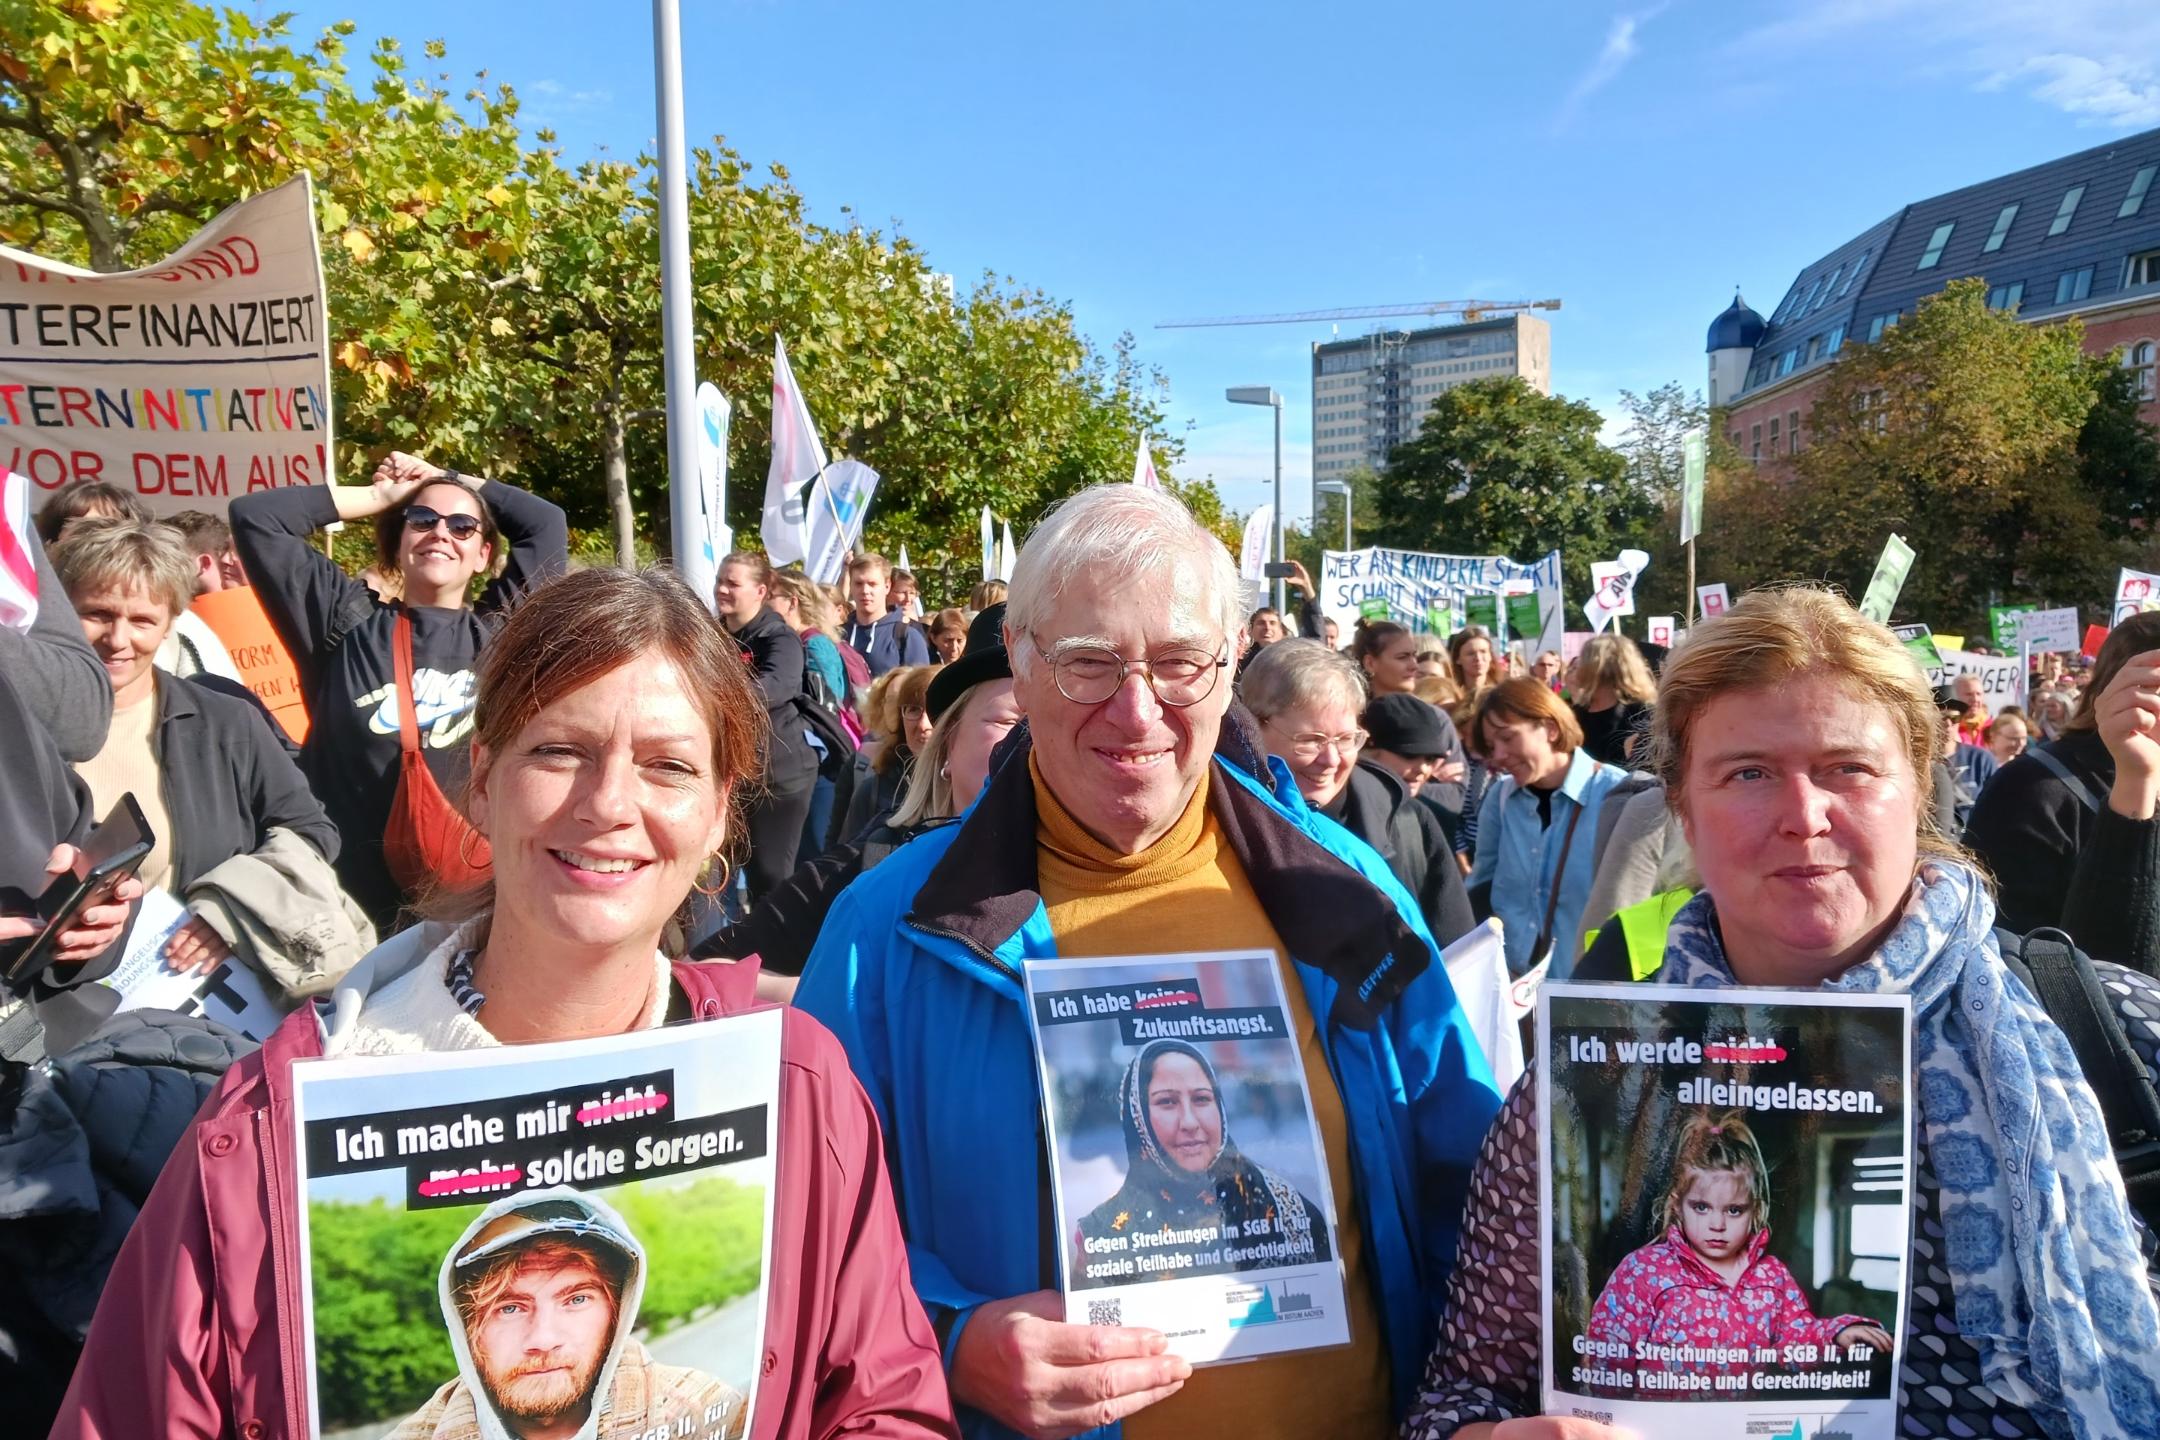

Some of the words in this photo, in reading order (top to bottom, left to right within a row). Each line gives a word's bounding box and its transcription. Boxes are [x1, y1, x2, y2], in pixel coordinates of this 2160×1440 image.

[1, 294, 314, 347] TERFINANZIERT
[0, 385, 327, 431] TERNINITIATIVEN
[10, 447, 104, 490] OR
[133, 453, 229, 496] DEM
[1326, 555, 1361, 579] WER
[1369, 550, 1393, 577] AN
[1402, 554, 1484, 585] KINDERN
[1337, 582, 1405, 608] SCHAUT
[248, 677, 280, 699] GEN
[1050, 997, 1078, 1018] Ich
[1083, 993, 1132, 1015] habe
[1133, 1014, 1273, 1038] Zukunftsangst.
[1570, 1035, 1607, 1062] Ich
[1616, 1036, 1702, 1063] werde
[1677, 1077, 1883, 1114] alleingelassen.
[336, 1125, 385, 1163] Ich
[397, 1113, 504, 1155] mache
[516, 1100, 571, 1140] mir
[526, 1145, 625, 1188] solche
[635, 1127, 744, 1170] Sorgen.
[1084, 1236, 1129, 1254] Gegen
[1132, 1224, 1218, 1250] Streichungen
[1222, 1225, 1239, 1239] im
[1243, 1218, 1269, 1237] SGB
[1086, 1257, 1133, 1279] soziale
[1136, 1251, 1193, 1273] Teilhabe
[1195, 1250, 1221, 1266] und
[1223, 1237, 1315, 1263] Gerechtigkeit!
[1572, 1335, 1629, 1360] Gegen
[1635, 1343, 1748, 1364] Streichungen
[1755, 1345, 1777, 1363] im
[1783, 1344, 1817, 1363] SGB
[1824, 1344, 1842, 1364] II,
[1847, 1343, 1873, 1361] für
[1572, 1366, 1633, 1388] soziale
[1637, 1370, 1711, 1390] Teilhabe
[1715, 1372, 1747, 1390] und
[1752, 1369, 1870, 1391] Gerechtigkeit!
[704, 1400, 730, 1426] für
